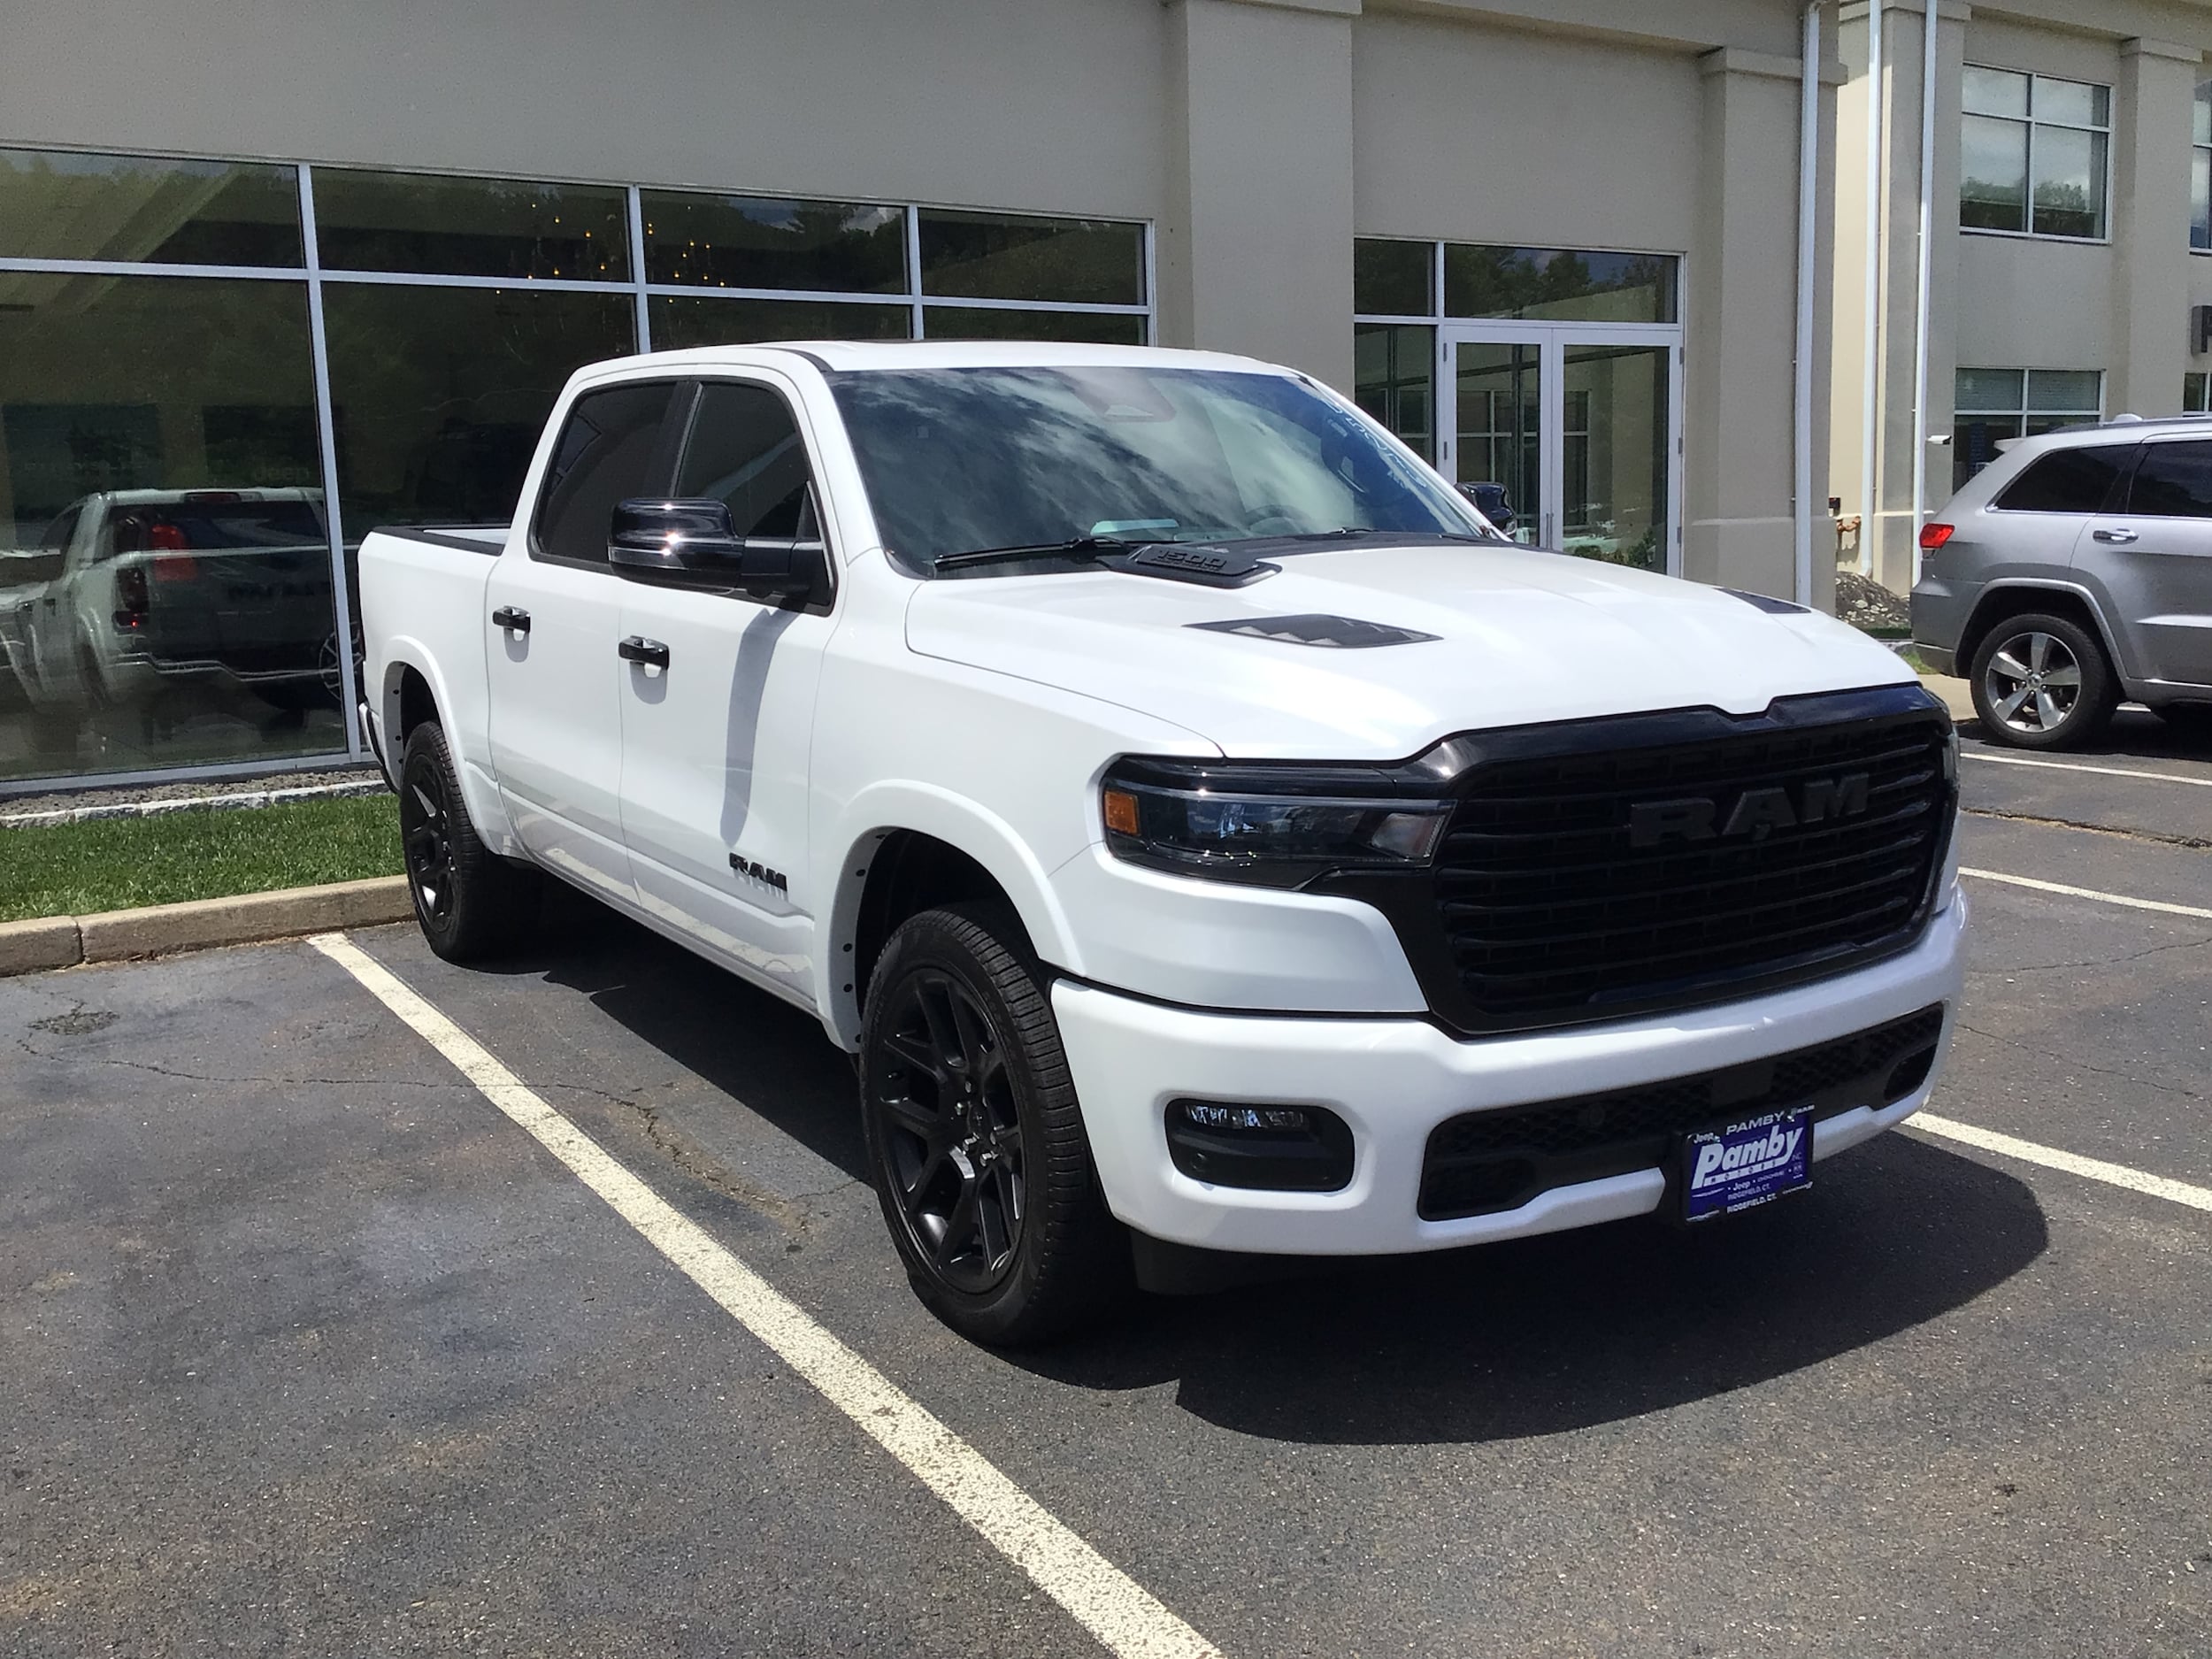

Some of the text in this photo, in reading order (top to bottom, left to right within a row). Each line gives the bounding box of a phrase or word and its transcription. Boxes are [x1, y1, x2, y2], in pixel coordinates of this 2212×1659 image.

[1156, 549, 1228, 569] 1500
[1630, 772, 1870, 848] RAM
[729, 852, 787, 892] RAM
[1726, 1110, 1785, 1135] PAMBY
[1691, 1125, 1804, 1190] Pamby
